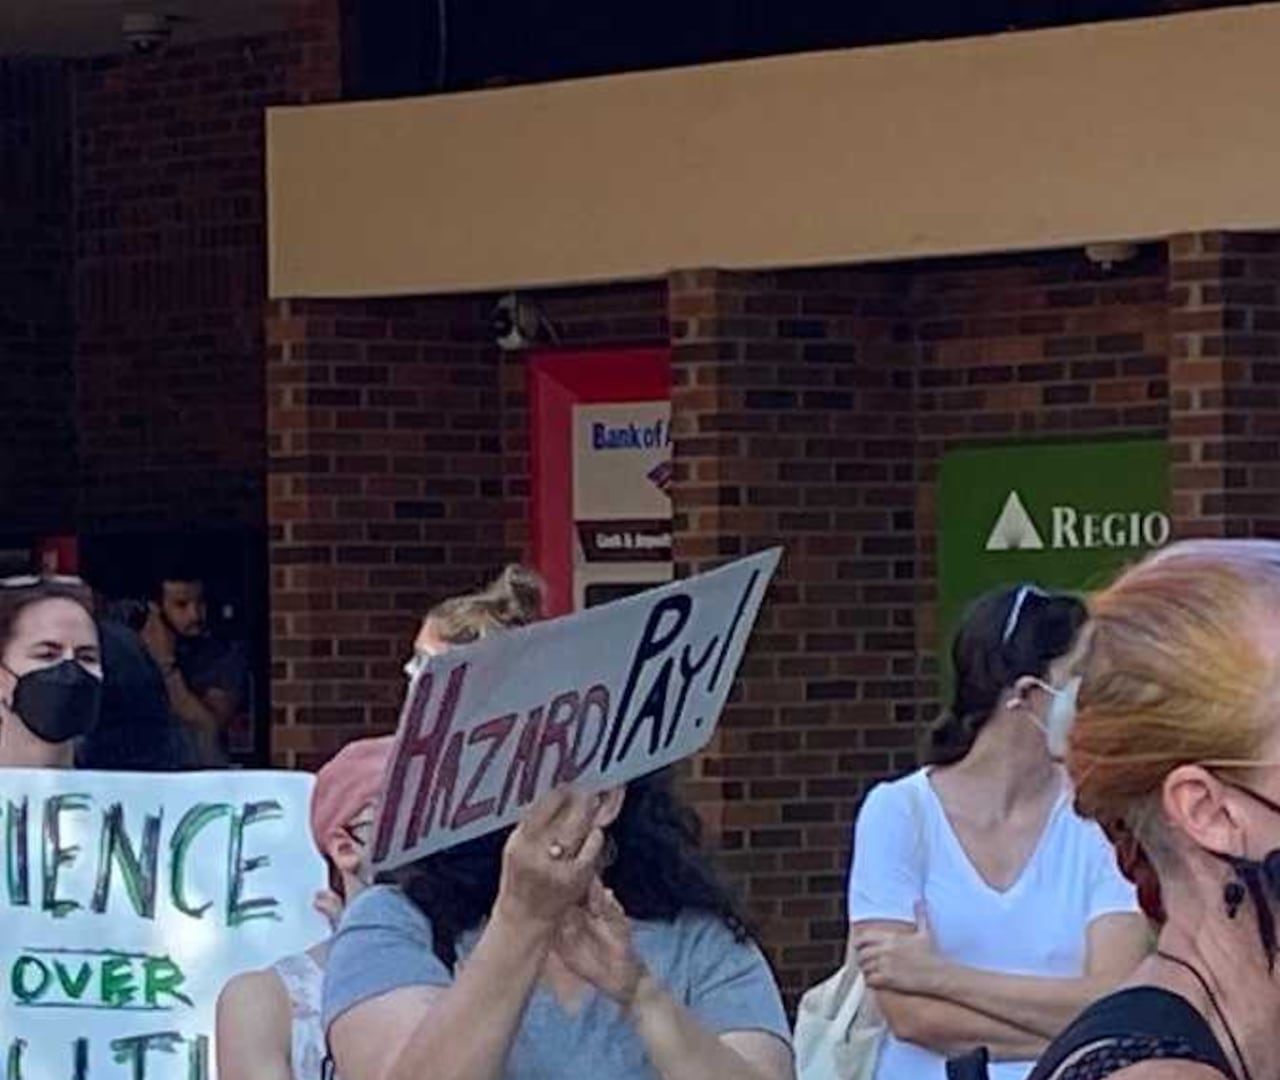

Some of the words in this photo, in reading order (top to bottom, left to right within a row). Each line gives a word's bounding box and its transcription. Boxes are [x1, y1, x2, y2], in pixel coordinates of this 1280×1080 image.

[592, 422, 642, 449] Bank
[643, 420, 664, 447] of
[372, 661, 611, 863] HAZARD
[601, 568, 760, 772] PAY!
[10, 954, 195, 1010] OVER
